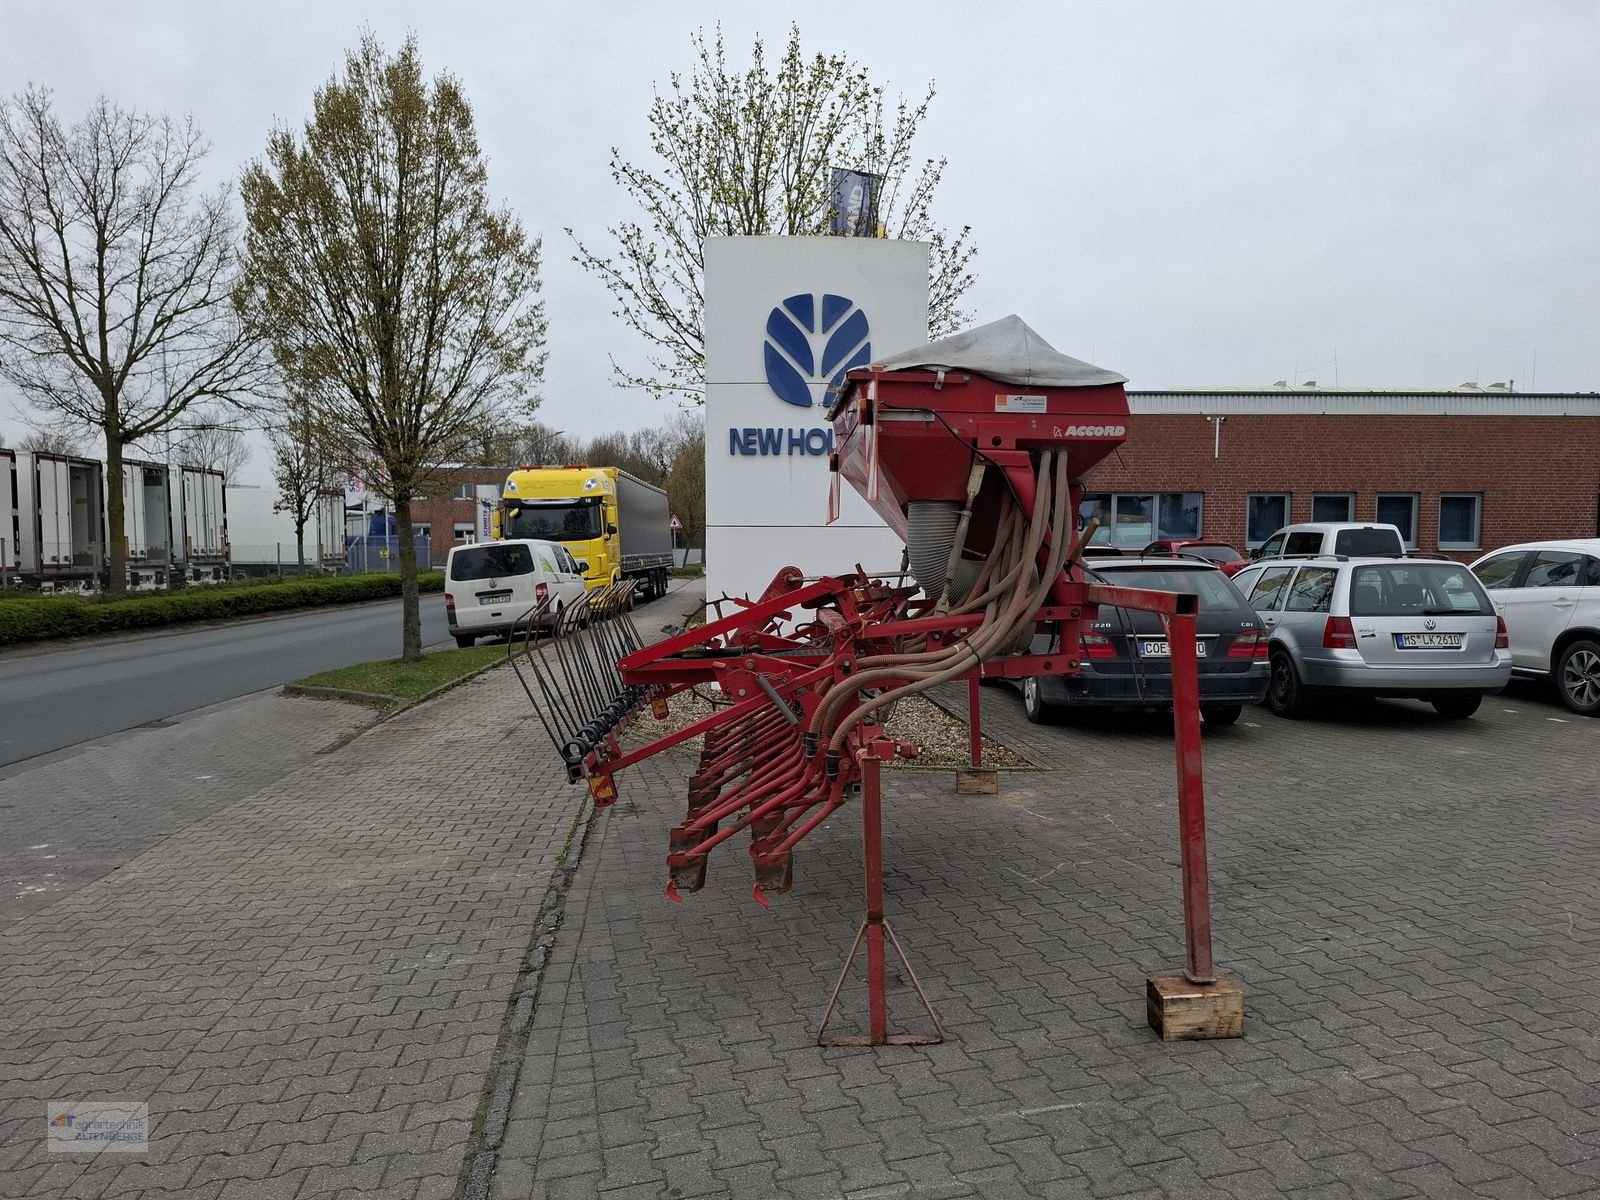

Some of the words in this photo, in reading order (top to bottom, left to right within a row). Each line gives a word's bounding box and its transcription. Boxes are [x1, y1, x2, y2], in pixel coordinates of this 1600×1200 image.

[1065, 425, 1126, 437] ACCORD
[729, 428, 784, 456] NEW
[1404, 635, 1417, 645] MS
[1423, 635, 1436, 645] LK
[1437, 635, 1460, 645] 2610
[1145, 642, 1167, 654] COE
